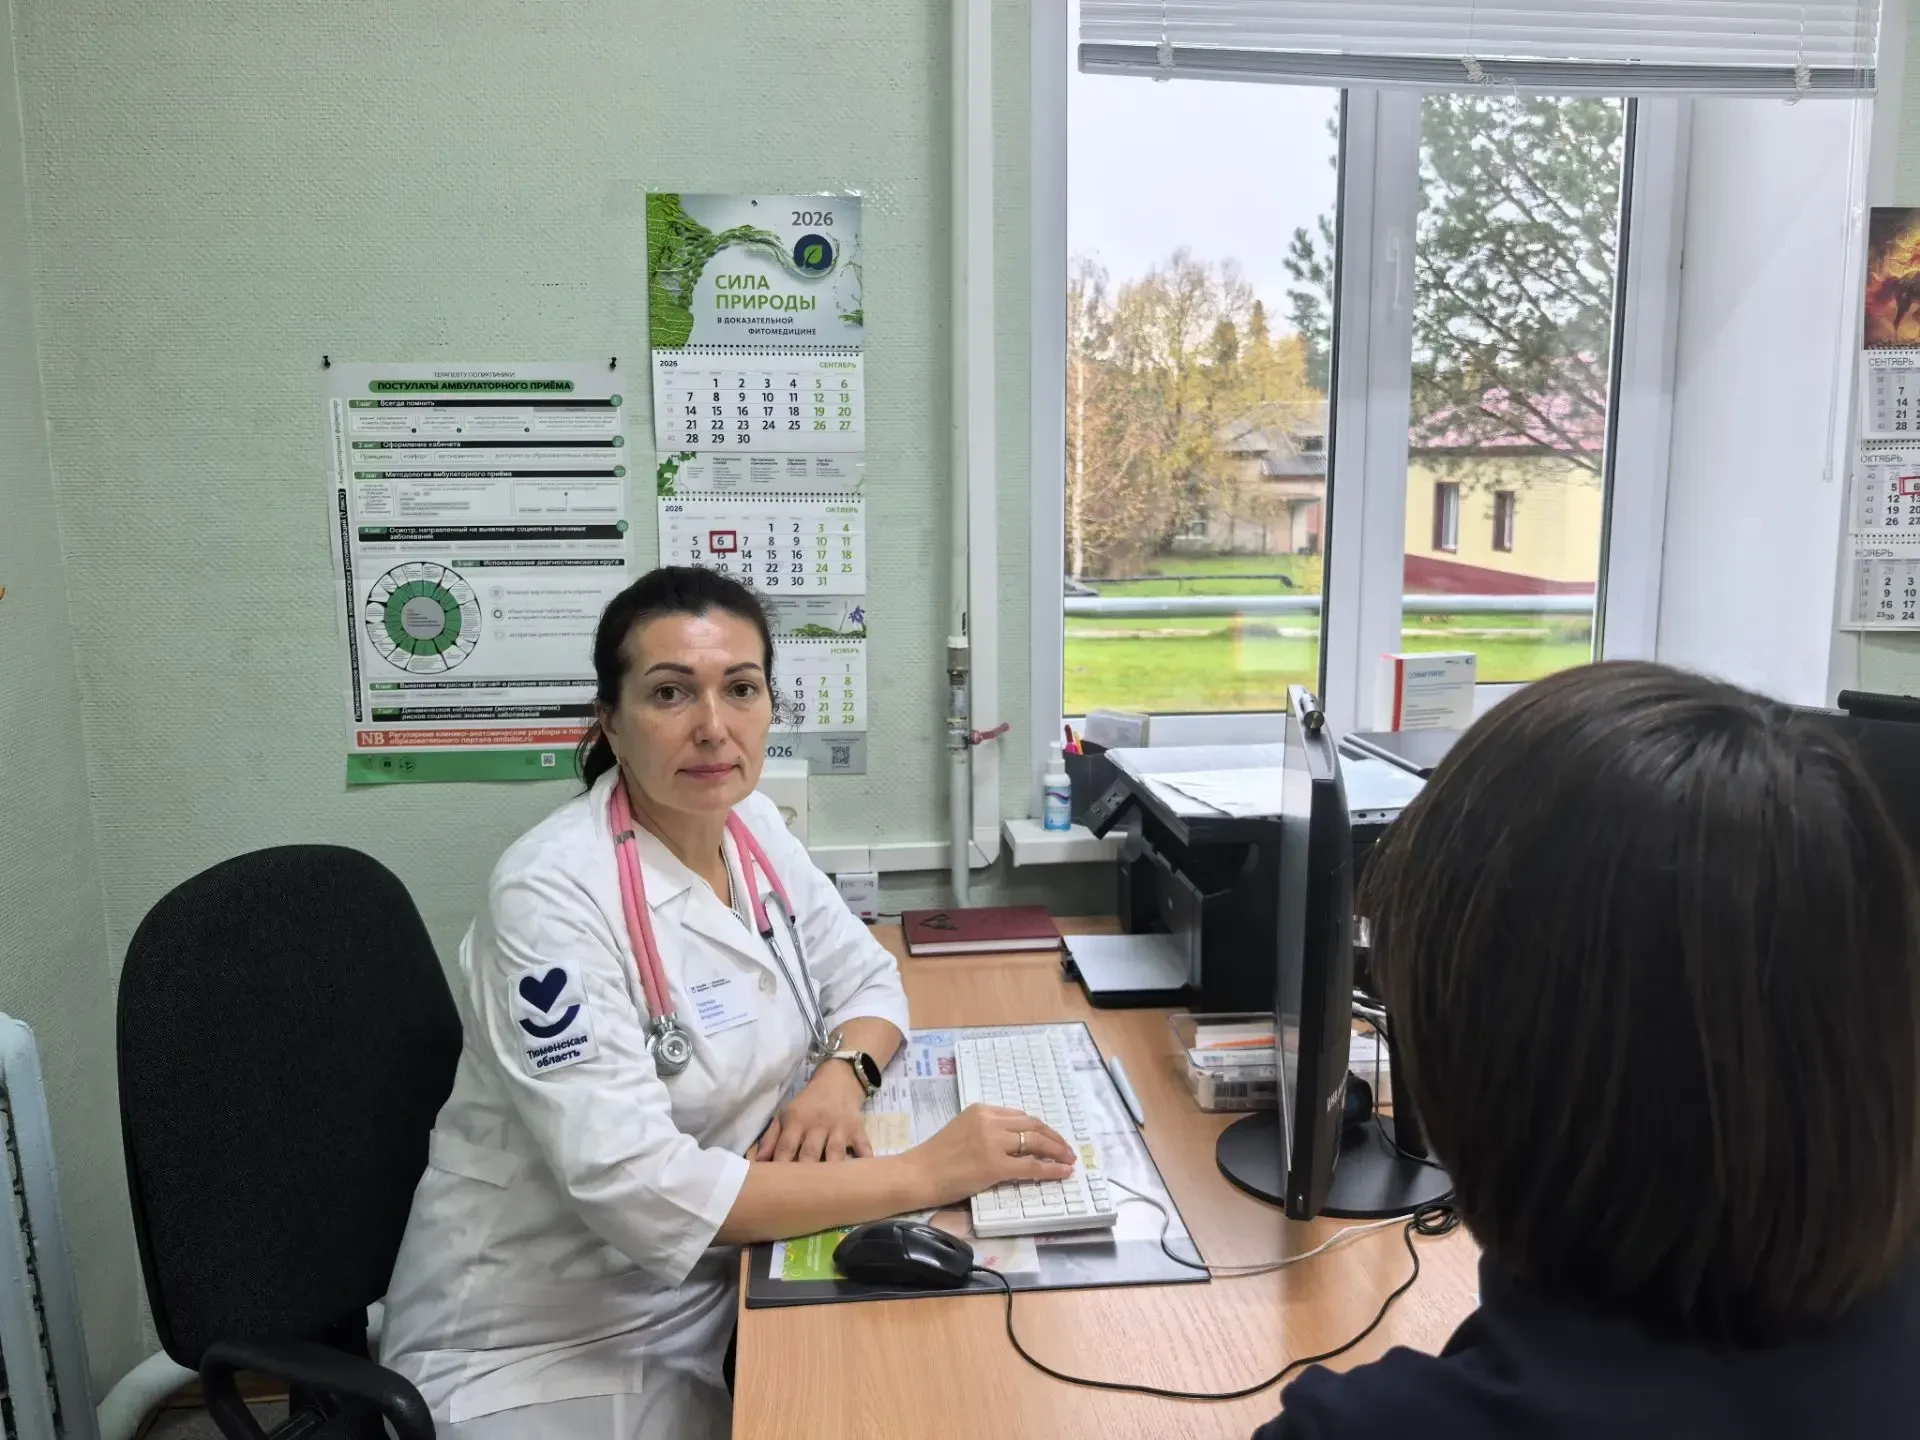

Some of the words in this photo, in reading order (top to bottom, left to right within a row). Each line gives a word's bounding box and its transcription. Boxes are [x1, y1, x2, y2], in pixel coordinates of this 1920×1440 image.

[792, 211, 833, 226] 2026
[715, 275, 769, 289] СИЛА
[716, 295, 816, 312] ПРИРОДЫ
[724, 317, 793, 325] ДОКАЗАТЕЛЬНОЙ
[749, 328, 816, 336] ФИТОМЕДИЦИНЕ
[1869, 358, 1914, 366] СЕНТЯБРЬ
[530, 381, 571, 390] ПРИЁМА
[713, 379, 718, 388] 1
[738, 379, 745, 388] 2
[765, 379, 770, 388] 3
[790, 379, 796, 388] 4
[816, 379, 821, 388] 5
[841, 379, 848, 388] 6
[1898, 387, 1904, 395] 7
[688, 392, 693, 401] 7
[713, 392, 719, 401] 8
[739, 392, 745, 401] 9
[762, 393, 774, 402] 10
[789, 393, 798, 402] 11
[814, 393, 824, 402] 12
[839, 393, 849, 402] 13
[1897, 398, 1907, 407] 14
[685, 406, 696, 415] 14
[712, 406, 722, 415] 15
[737, 407, 748, 416] 16
[763, 407, 773, 416] 17
[789, 407, 799, 416] 18
[814, 407, 824, 416] 19
[838, 407, 851, 416] 20
[1896, 410, 1906, 418] 21
[686, 420, 696, 429] 21
[712, 420, 723, 430] 22
[738, 420, 749, 430] 23
[762, 420, 775, 430] 24
[789, 421, 800, 430] 25
[814, 421, 826, 430] 26
[840, 421, 851, 430] 27
[1896, 422, 1907, 430] 28
[686, 434, 698, 443] 28
[712, 434, 724, 443] 29
[737, 434, 750, 443] 30
[336, 436, 344, 485] Амбулаторный
[1861, 455, 1902, 463] ОКТЯБРЬ
[1892, 483, 1897, 491] 5
[1888, 495, 1900, 503] 12
[1887, 506, 1899, 514] 19
[769, 524, 773, 532] 1
[793, 524, 799, 532] 2
[819, 524, 824, 532] 3
[843, 524, 849, 532] 4
[693, 536, 698, 545] 5
[717, 536, 724, 545] 6
[743, 537, 748, 546] 7
[768, 537, 774, 546] 8
[793, 537, 800, 546] 9
[816, 537, 827, 546] 10
[842, 537, 850, 546] 11
[691, 550, 701, 559] 12
[741, 550, 752, 559] 14
[767, 550, 776, 559] 15
[792, 550, 802, 559] 16
[817, 550, 826, 559] 17
[842, 550, 852, 559] 18
[715, 564, 728, 572] 20
[742, 563, 752, 572] 21
[766, 563, 777, 572] 22
[792, 564, 803, 572] 23
[816, 564, 828, 572] 24
[841, 564, 852, 572] 25
[742, 577, 753, 585] 28
[766, 577, 778, 586] 29
[791, 577, 804, 586] 30
[817, 577, 827, 586] 31
[1908, 577, 1914, 585] 3
[1884, 589, 1890, 597] 9
[1904, 589, 1916, 597] 10
[1902, 612, 1914, 620] 24
[845, 664, 849, 672] 1
[796, 677, 802, 686] 6
[820, 677, 826, 686] 7
[844, 677, 851, 686] 8
[794, 690, 804, 699] 13
[818, 690, 828, 698] 14
[844, 690, 852, 698] 15
[793, 703, 805, 711] 20
[819, 703, 829, 711] 21
[843, 703, 854, 711] 22
[794, 716, 805, 724] 27
[818, 716, 830, 724] 28
[843, 715, 854, 724] 29
[361, 732, 384, 744] NB
[766, 747, 792, 757] 026
[527, 1035, 588, 1060] Тюменская
[537, 1050, 580, 1068] область
